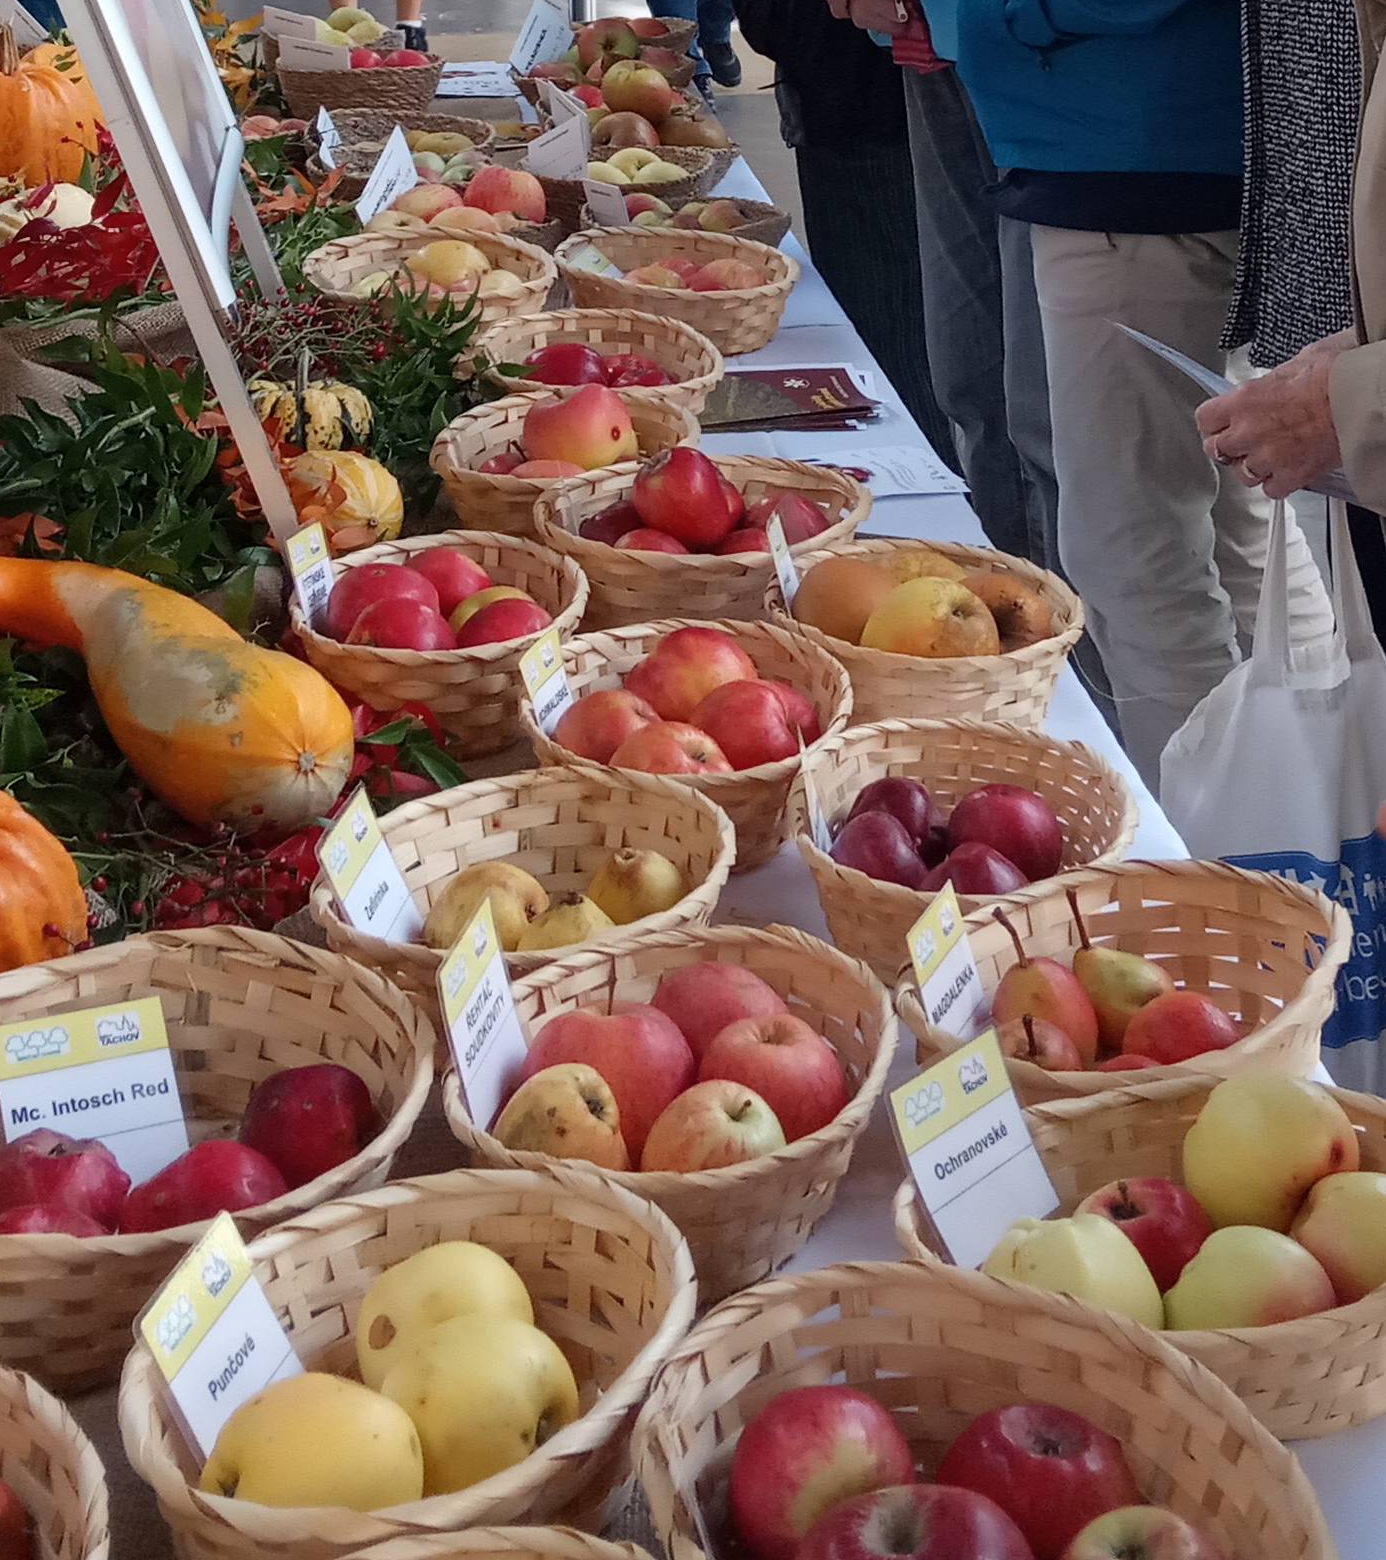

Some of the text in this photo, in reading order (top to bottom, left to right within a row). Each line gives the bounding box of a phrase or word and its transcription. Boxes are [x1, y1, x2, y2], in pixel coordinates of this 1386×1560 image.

[932, 964, 974, 1025] MAGDALENKA
[11, 1078, 169, 1125] Mc. Intosch Red
[934, 1120, 1009, 1181] Ochranovské
[208, 1332, 256, 1401] Punčové
